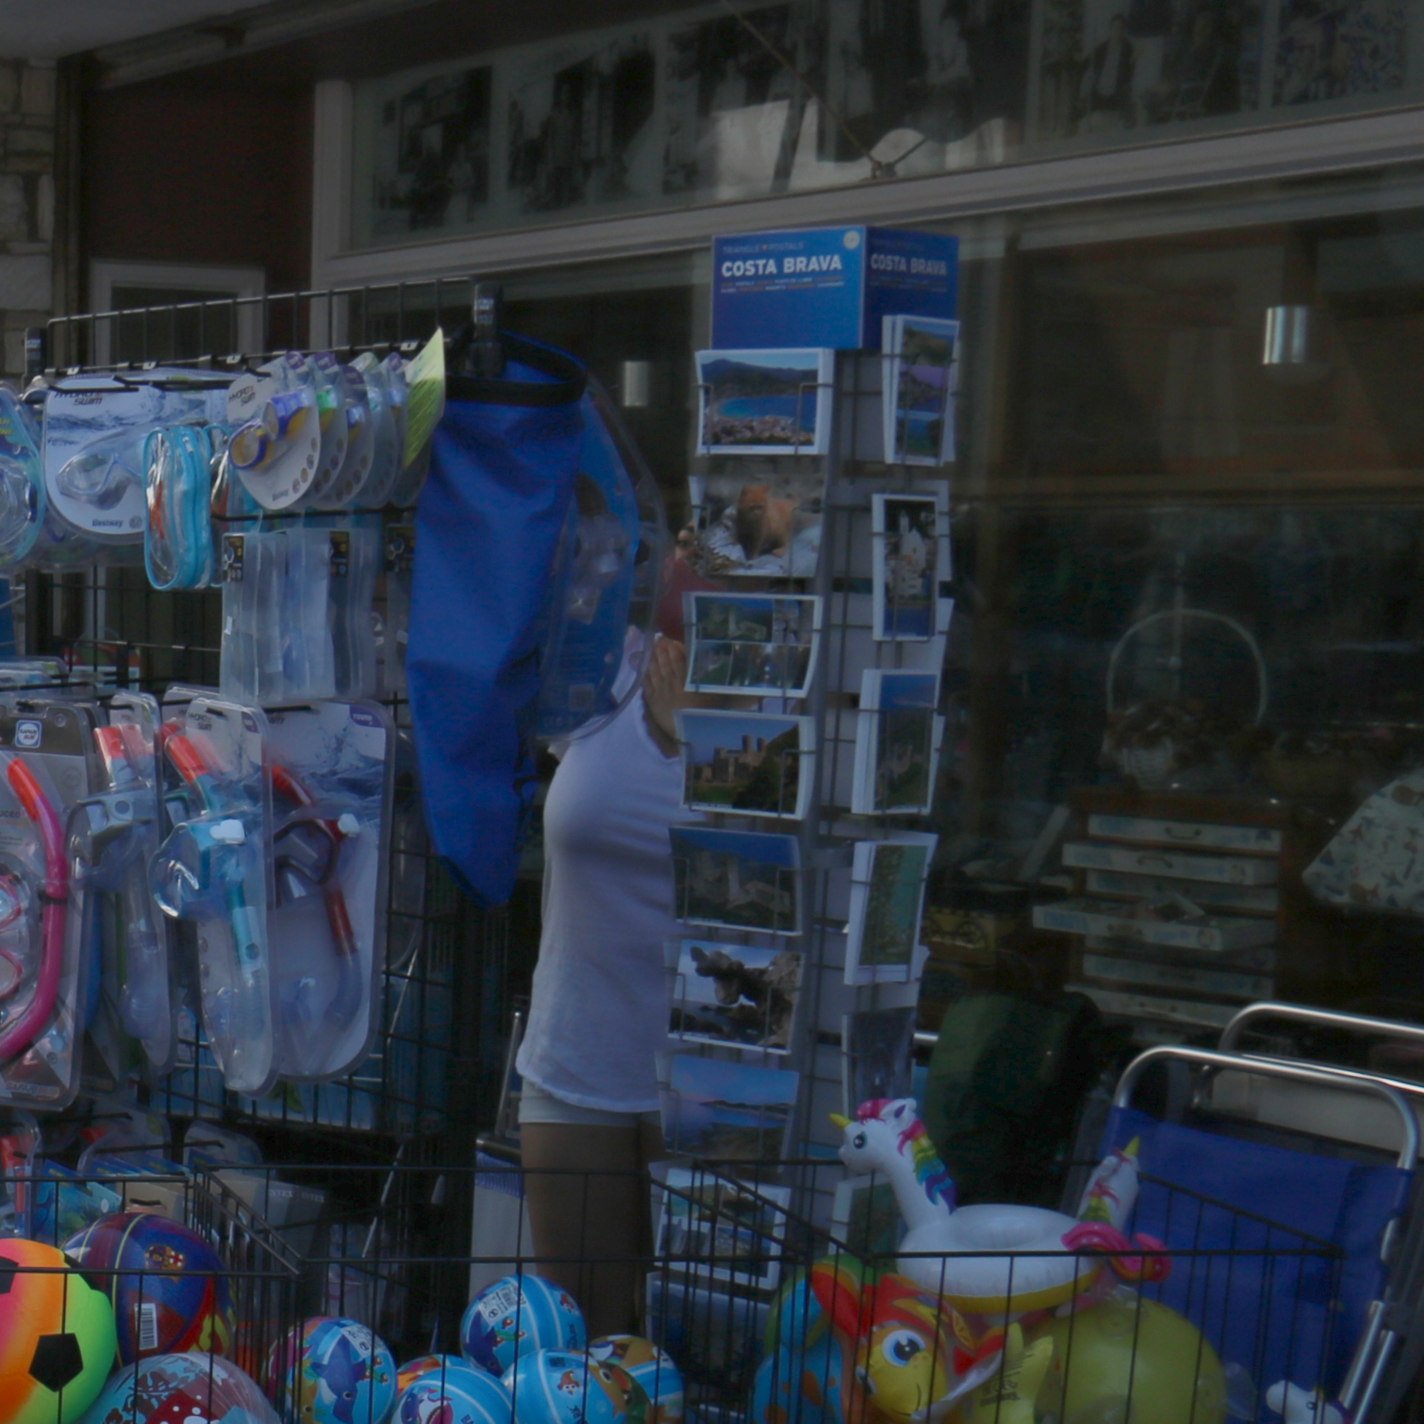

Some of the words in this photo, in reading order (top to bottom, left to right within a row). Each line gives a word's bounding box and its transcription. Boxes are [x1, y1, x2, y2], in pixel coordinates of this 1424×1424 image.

[721, 258, 777, 278] COSTA
[783, 253, 843, 274] BRAVA
[870, 252, 907, 271] COSTA
[910, 257, 948, 276] BRAVA
